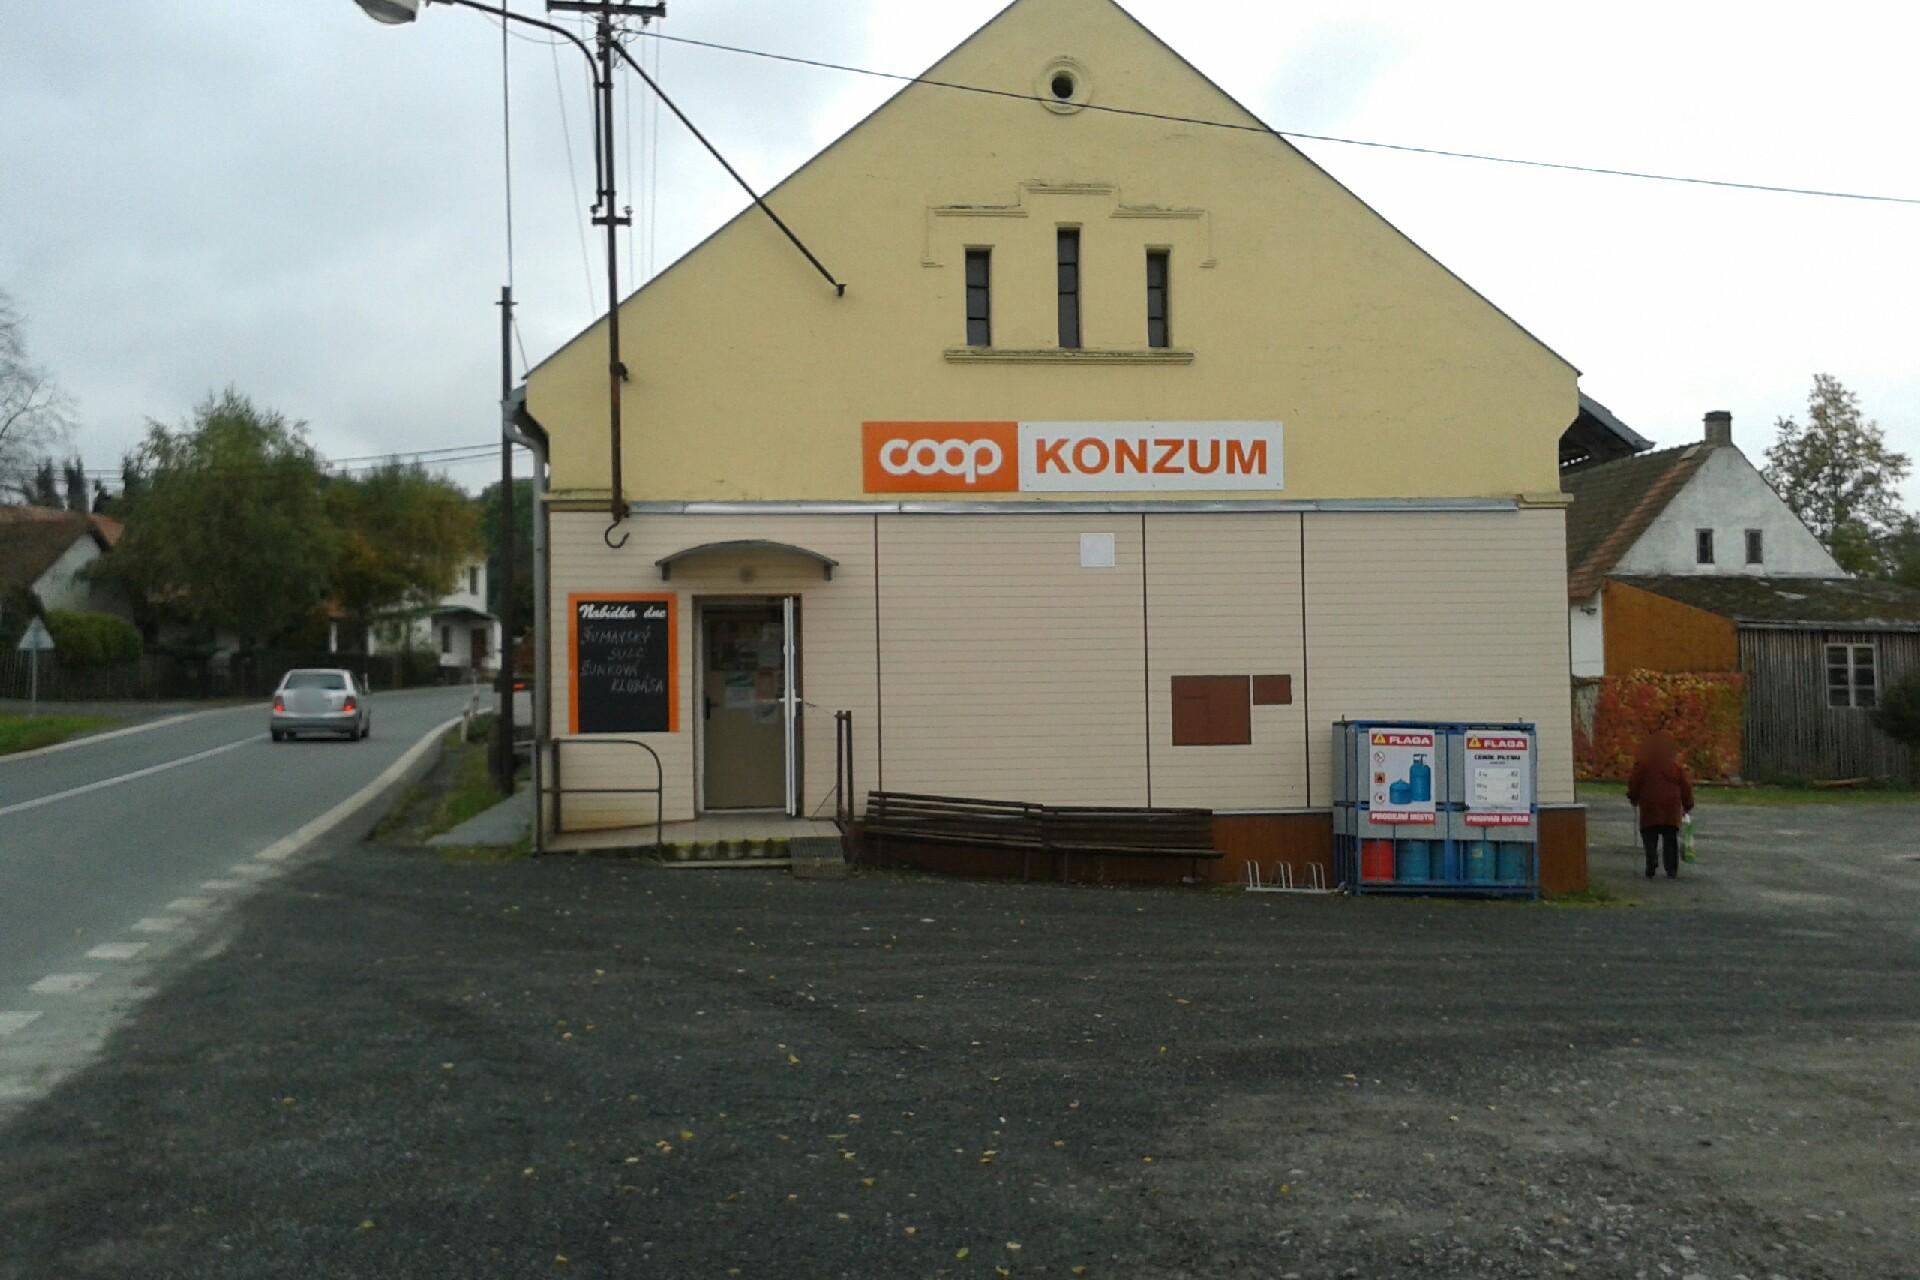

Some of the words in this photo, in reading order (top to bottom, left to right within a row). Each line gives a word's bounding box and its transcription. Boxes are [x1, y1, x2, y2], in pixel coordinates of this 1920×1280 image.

[879, 437, 1002, 484] coop
[1035, 437, 1268, 475] KONZUM
[643, 605, 667, 619] dne
[1389, 735, 1431, 745] FLAGA
[1483, 739, 1525, 748] FLAGA
